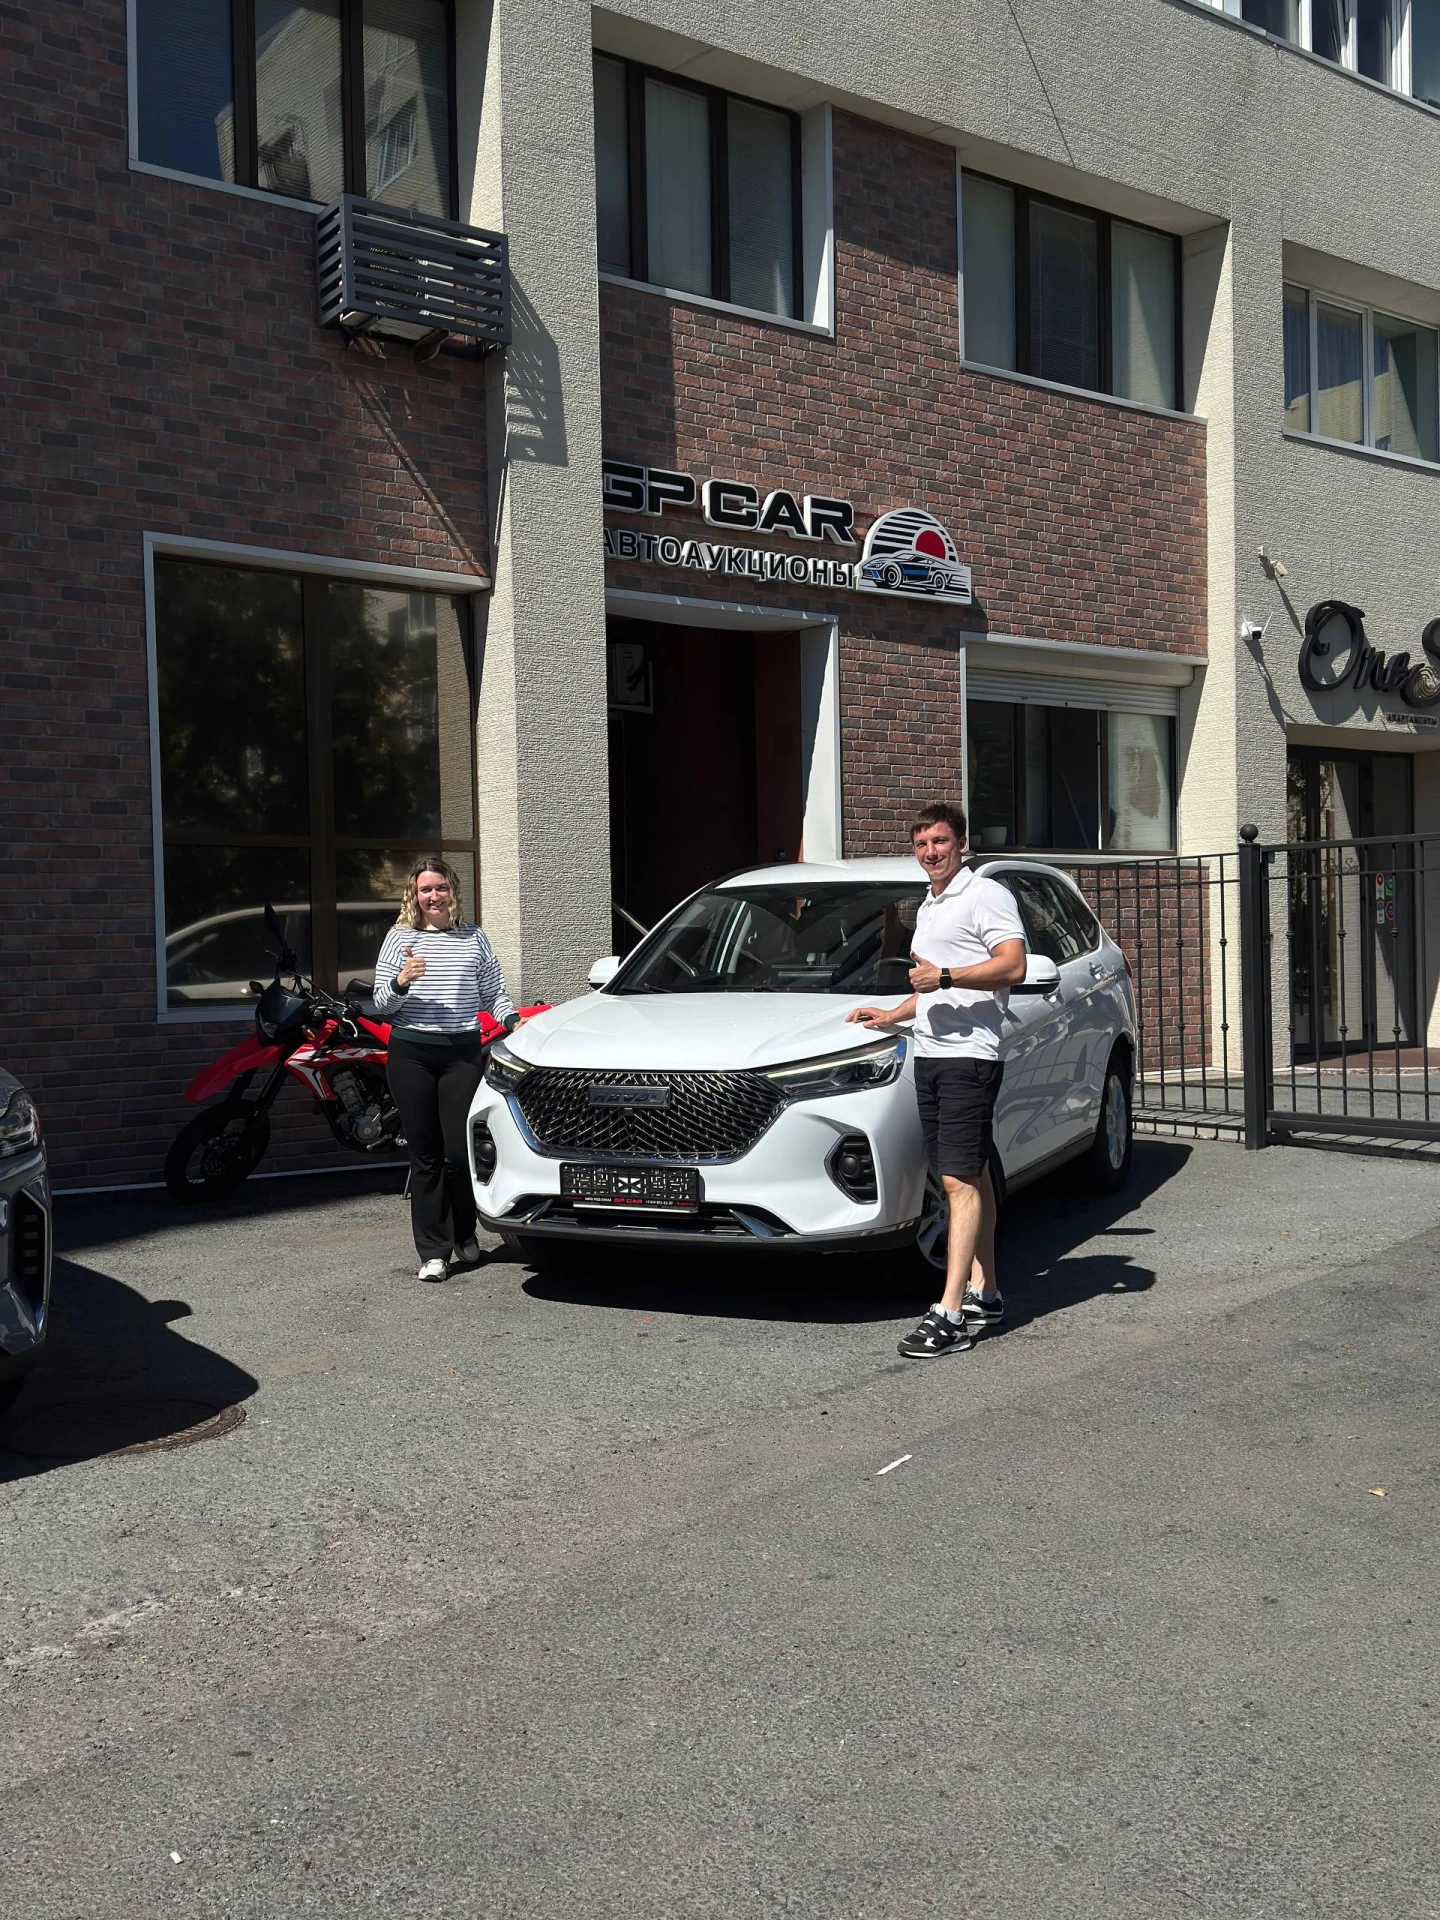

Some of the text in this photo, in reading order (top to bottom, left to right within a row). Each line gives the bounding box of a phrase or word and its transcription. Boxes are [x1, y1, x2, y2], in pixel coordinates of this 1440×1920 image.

[602, 460, 856, 546] GP CAR
[603, 527, 854, 589] АВТОАУКЦИОНЫ
[1298, 600, 1411, 692] One
